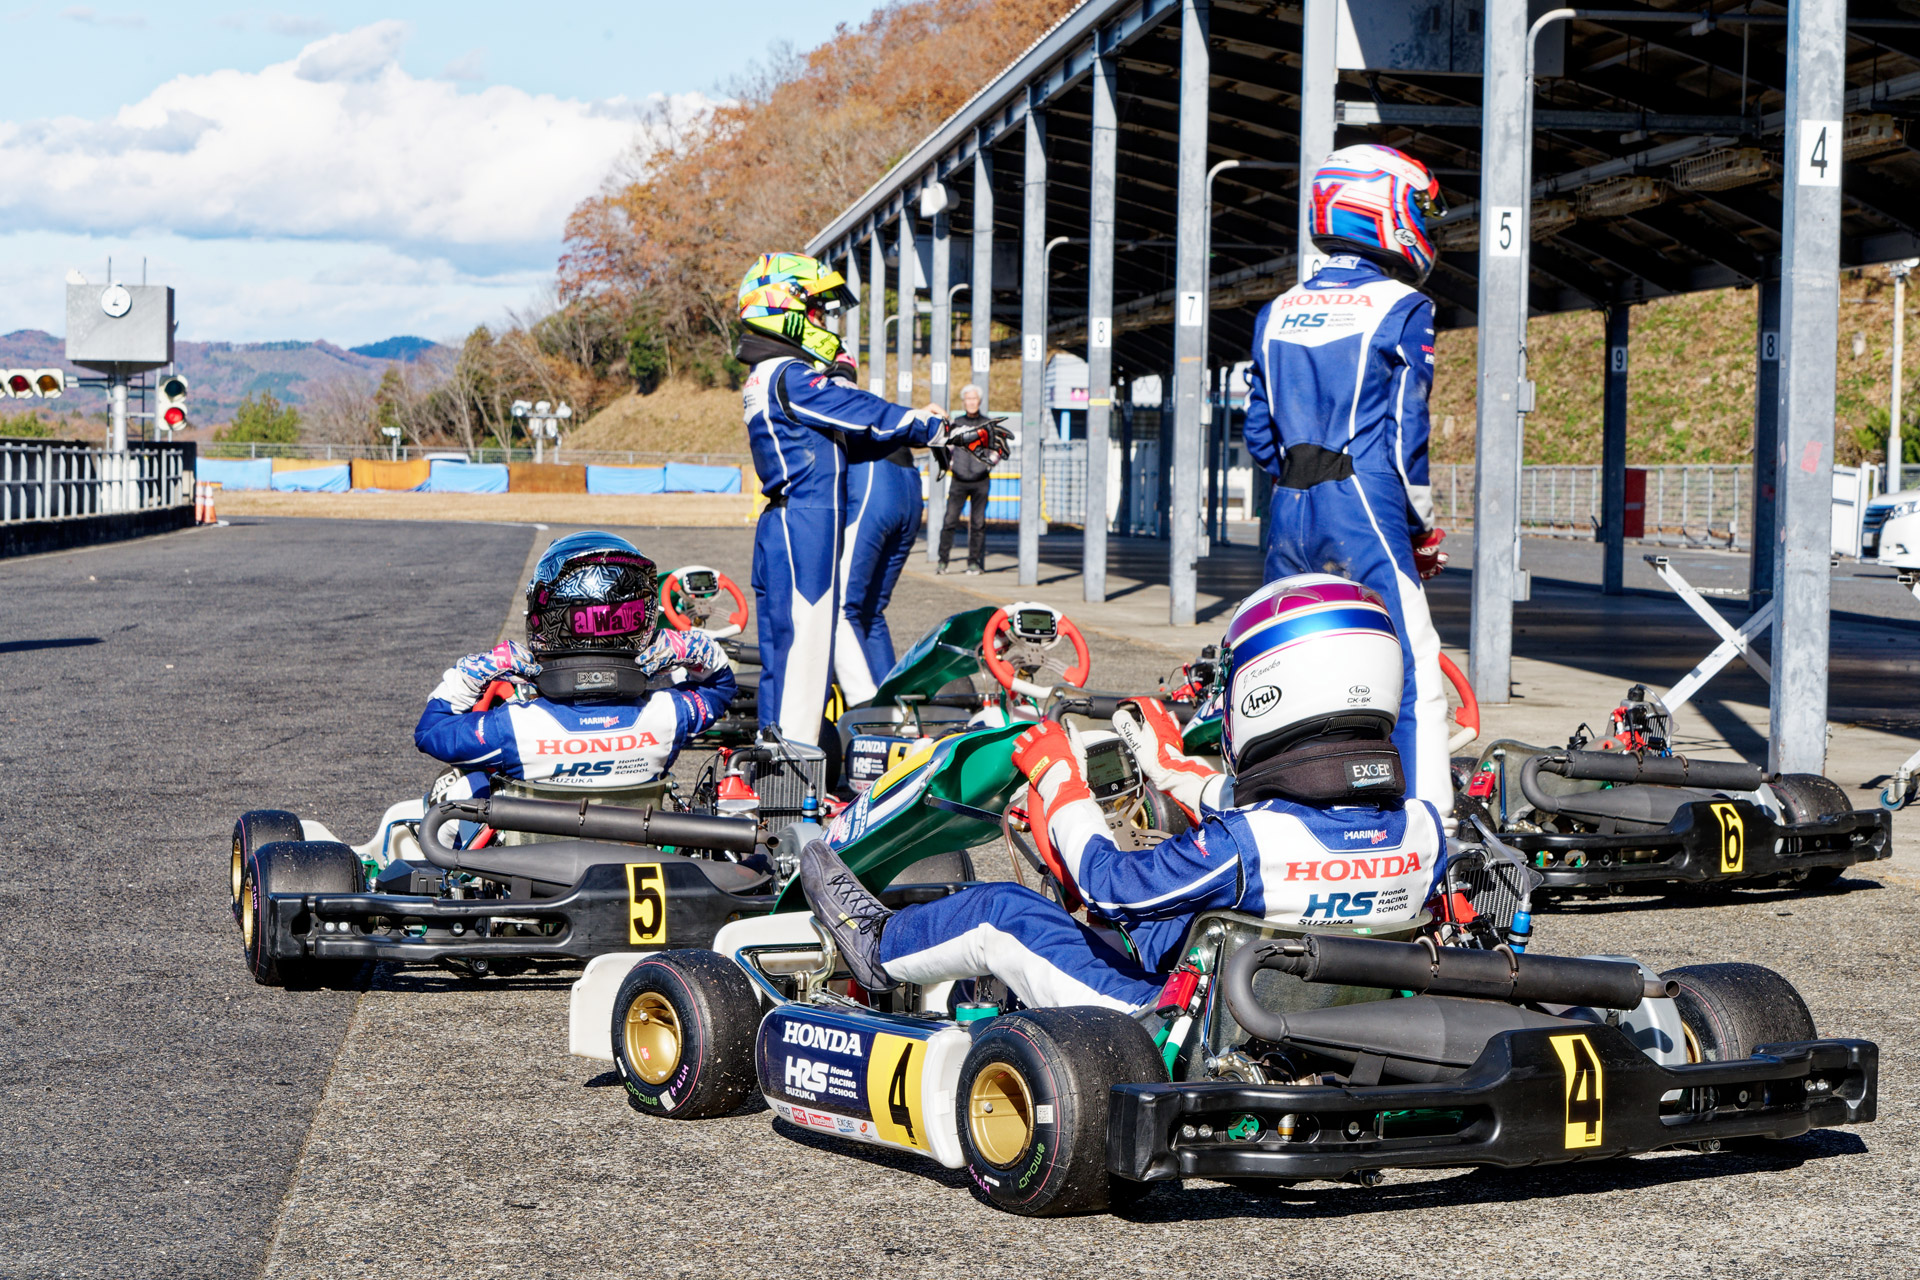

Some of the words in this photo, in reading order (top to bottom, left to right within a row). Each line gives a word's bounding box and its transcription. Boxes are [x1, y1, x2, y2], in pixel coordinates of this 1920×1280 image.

[1810, 126, 1828, 178] 4
[1499, 212, 1512, 250] 5
[1188, 296, 1196, 321] 7
[1280, 294, 1374, 310] HONDA
[1281, 313, 1329, 329] HRS
[1098, 321, 1105, 343] 8
[1031, 338, 1037, 358] 9
[1765, 335, 1776, 358] 8
[976, 351, 987, 368] 10
[1614, 349, 1624, 370] 9
[935, 365, 944, 382] 11
[579, 716, 611, 726] MARINA
[535, 731, 660, 755] HONDA
[1121, 721, 1142, 752] Sabelt
[853, 740, 887, 753] HONDA
[550, 760, 616, 777] HRS
[616, 762, 649, 770] RACING
[618, 757, 645, 765] Honda
[614, 767, 650, 775] SCHOOL
[1352, 763, 1390, 778] EXGEL
[1343, 829, 1379, 841] MARINA
[1719, 806, 1741, 869] 6
[1283, 851, 1422, 882] HONDA
[1378, 894, 1409, 906] RACING
[1381, 888, 1407, 897] Honda
[632, 866, 663, 940] 5
[1302, 891, 1379, 919] HRS
[1376, 903, 1408, 914] SCHOOL
[1298, 918, 1354, 926] SUZUKA
[782, 1021, 863, 1057] HONDA
[785, 1056, 830, 1093] HRS
[830, 1065, 853, 1077] Honda
[829, 1076, 857, 1089] RACING
[1568, 1038, 1601, 1142] 4
[785, 1085, 817, 1102] SUZUKA
[828, 1086, 859, 1100] SCHOOL
[889, 1042, 918, 1145] 4
[1018, 1151, 1043, 1190] MOJO
